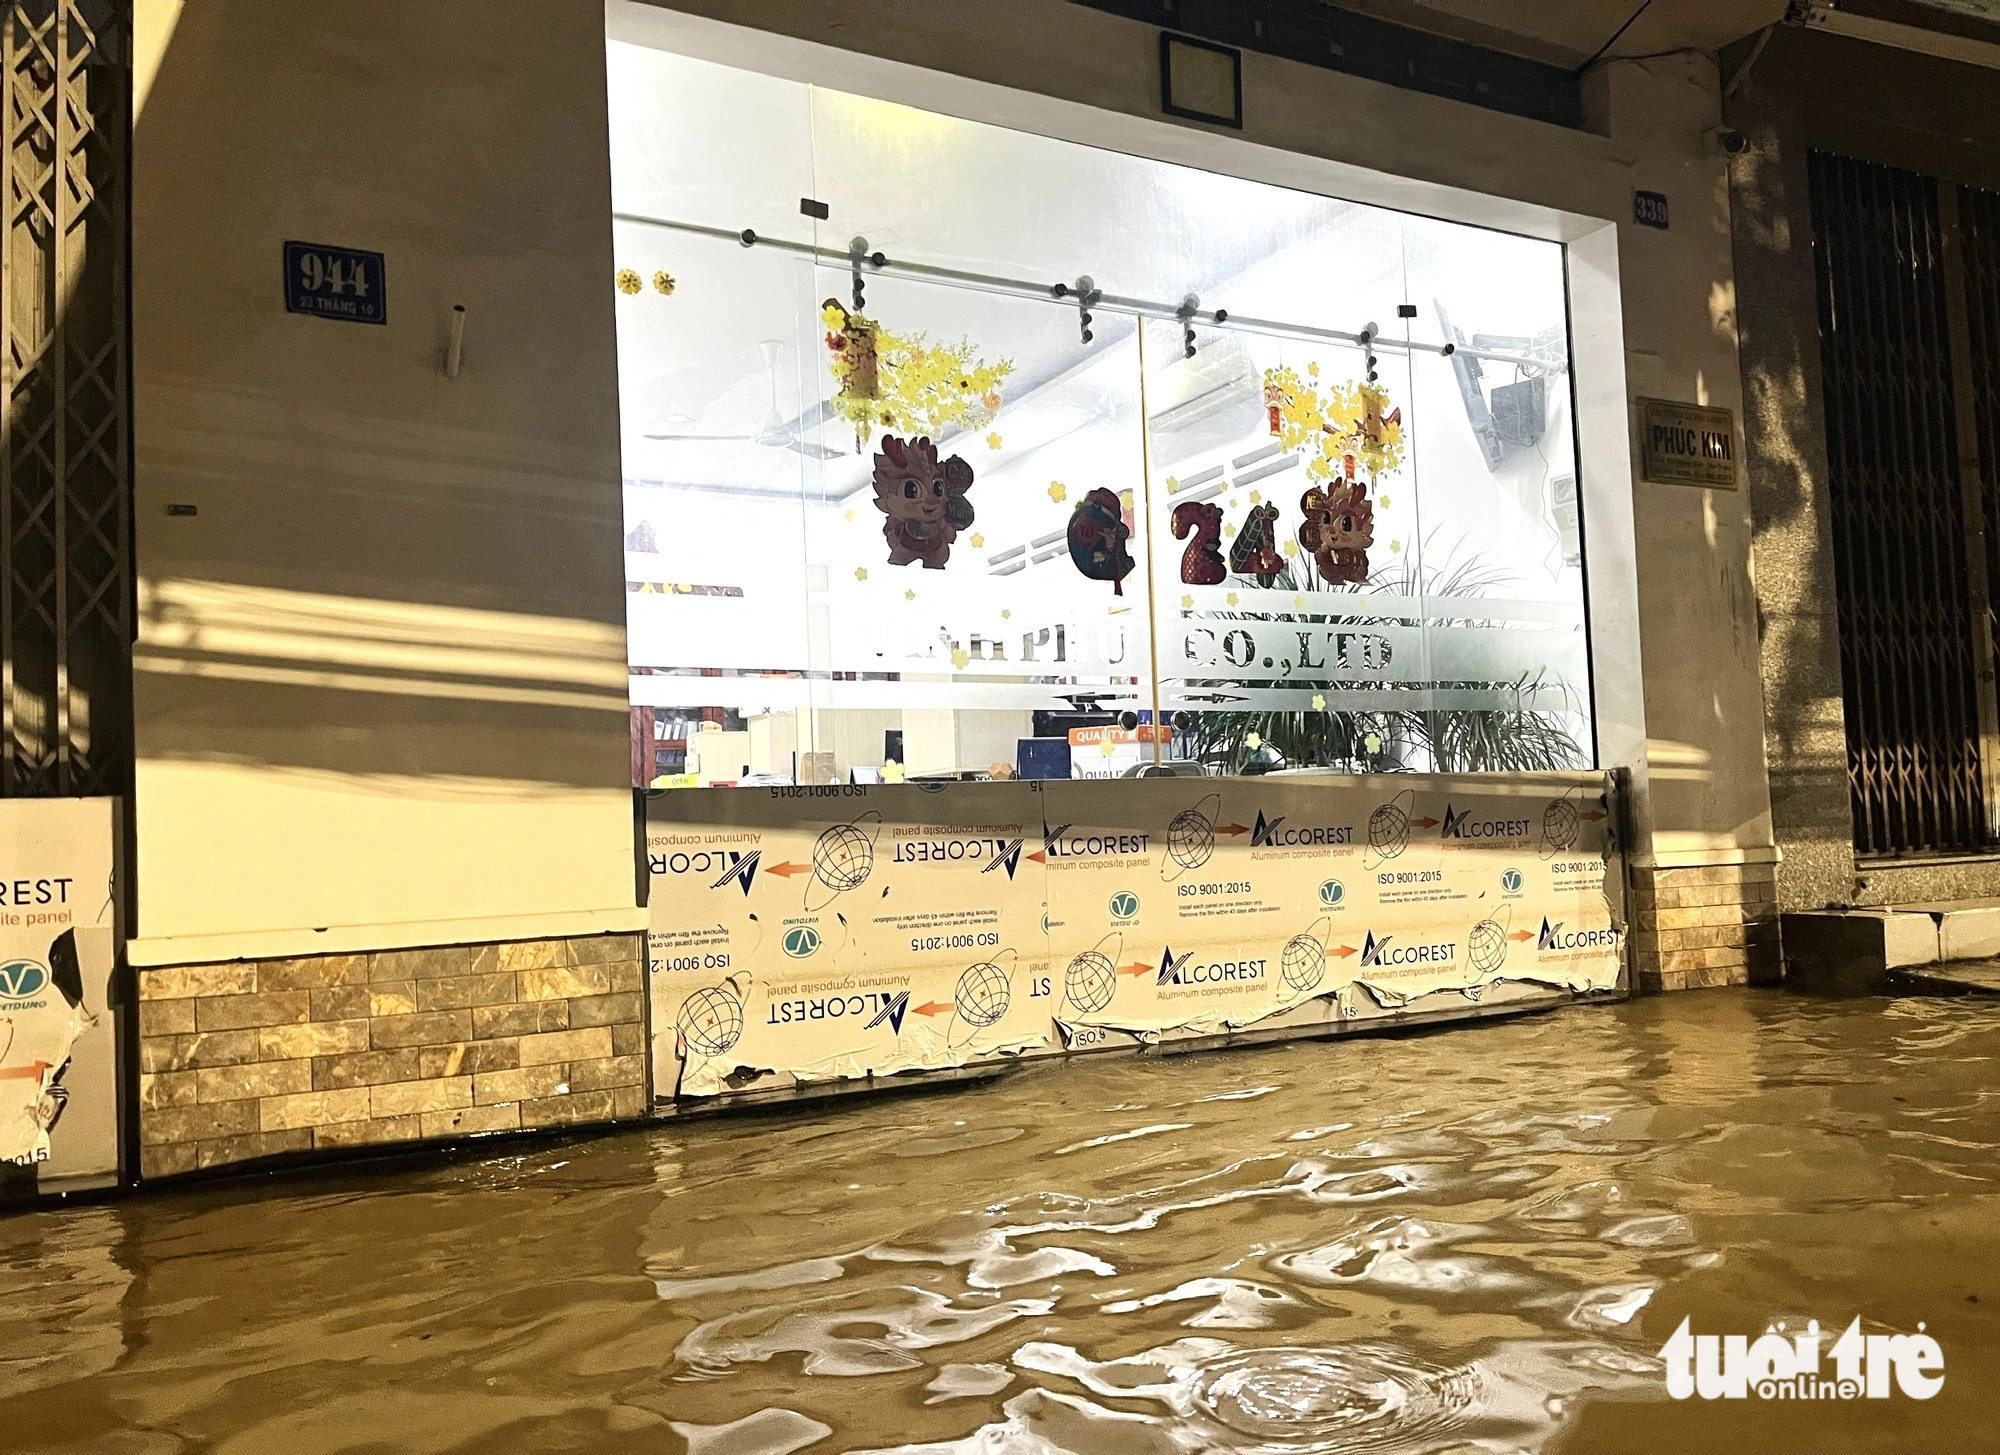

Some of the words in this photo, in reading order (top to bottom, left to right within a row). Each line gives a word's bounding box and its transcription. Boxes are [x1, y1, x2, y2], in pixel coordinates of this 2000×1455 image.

[300, 253, 369, 297] 944
[361, 304, 374, 315] 10
[1653, 420, 1696, 456] PHÚC
[1701, 431, 1730, 460] KIM
[1076, 729, 1125, 743] QUALITY
[843, 785, 867, 797] ISO
[978, 823, 1023, 834] Aluminum
[1250, 809, 1353, 847] ALCOREST
[1441, 803, 1530, 838] ALCOREST
[704, 833, 762, 844] Aluminum
[892, 826, 921, 839] panel
[923, 824, 974, 836] composite
[893, 838, 1024, 882] ALCOREST
[1251, 850, 1290, 861] Aluminum
[1292, 849, 1331, 860] composite
[1333, 847, 1354, 858] panel
[1079, 858, 1124, 871] composite
[1127, 857, 1150, 869] panel
[1552, 863, 1567, 873] ISO
[650, 850, 762, 897] ALCOR
[1378, 873, 1395, 884] ISO
[1397, 870, 1442, 884] 9001:2015
[1177, 885, 1197, 897] ISO
[1199, 881, 1251, 895] 9001:2015
[26, 909, 72, 927] panel
[674, 939, 693, 948] panel
[911, 934, 974, 951] 9001:2015
[977, 932, 999, 946] ISO
[1360, 929, 1456, 967] ALCOREST
[651, 956, 700, 973] 9001:2
[1156, 945, 1267, 986] ALCOREST
[1361, 970, 1398, 981] Aluminum
[1399, 967, 1436, 978] composite
[1437, 964, 1457, 975] panel
[801, 977, 856, 995] composite
[858, 975, 911, 988] Aluminum
[1030, 978, 1050, 997] ST
[767, 982, 798, 999] panel
[1156, 990, 1199, 1001] Aluminum
[1201, 986, 1243, 998] composite
[1245, 982, 1268, 994] panel
[767, 991, 911, 1036] ALCOREST
[1075, 1031, 1097, 1047] ISO
[9, 1147, 48, 1168] 015
